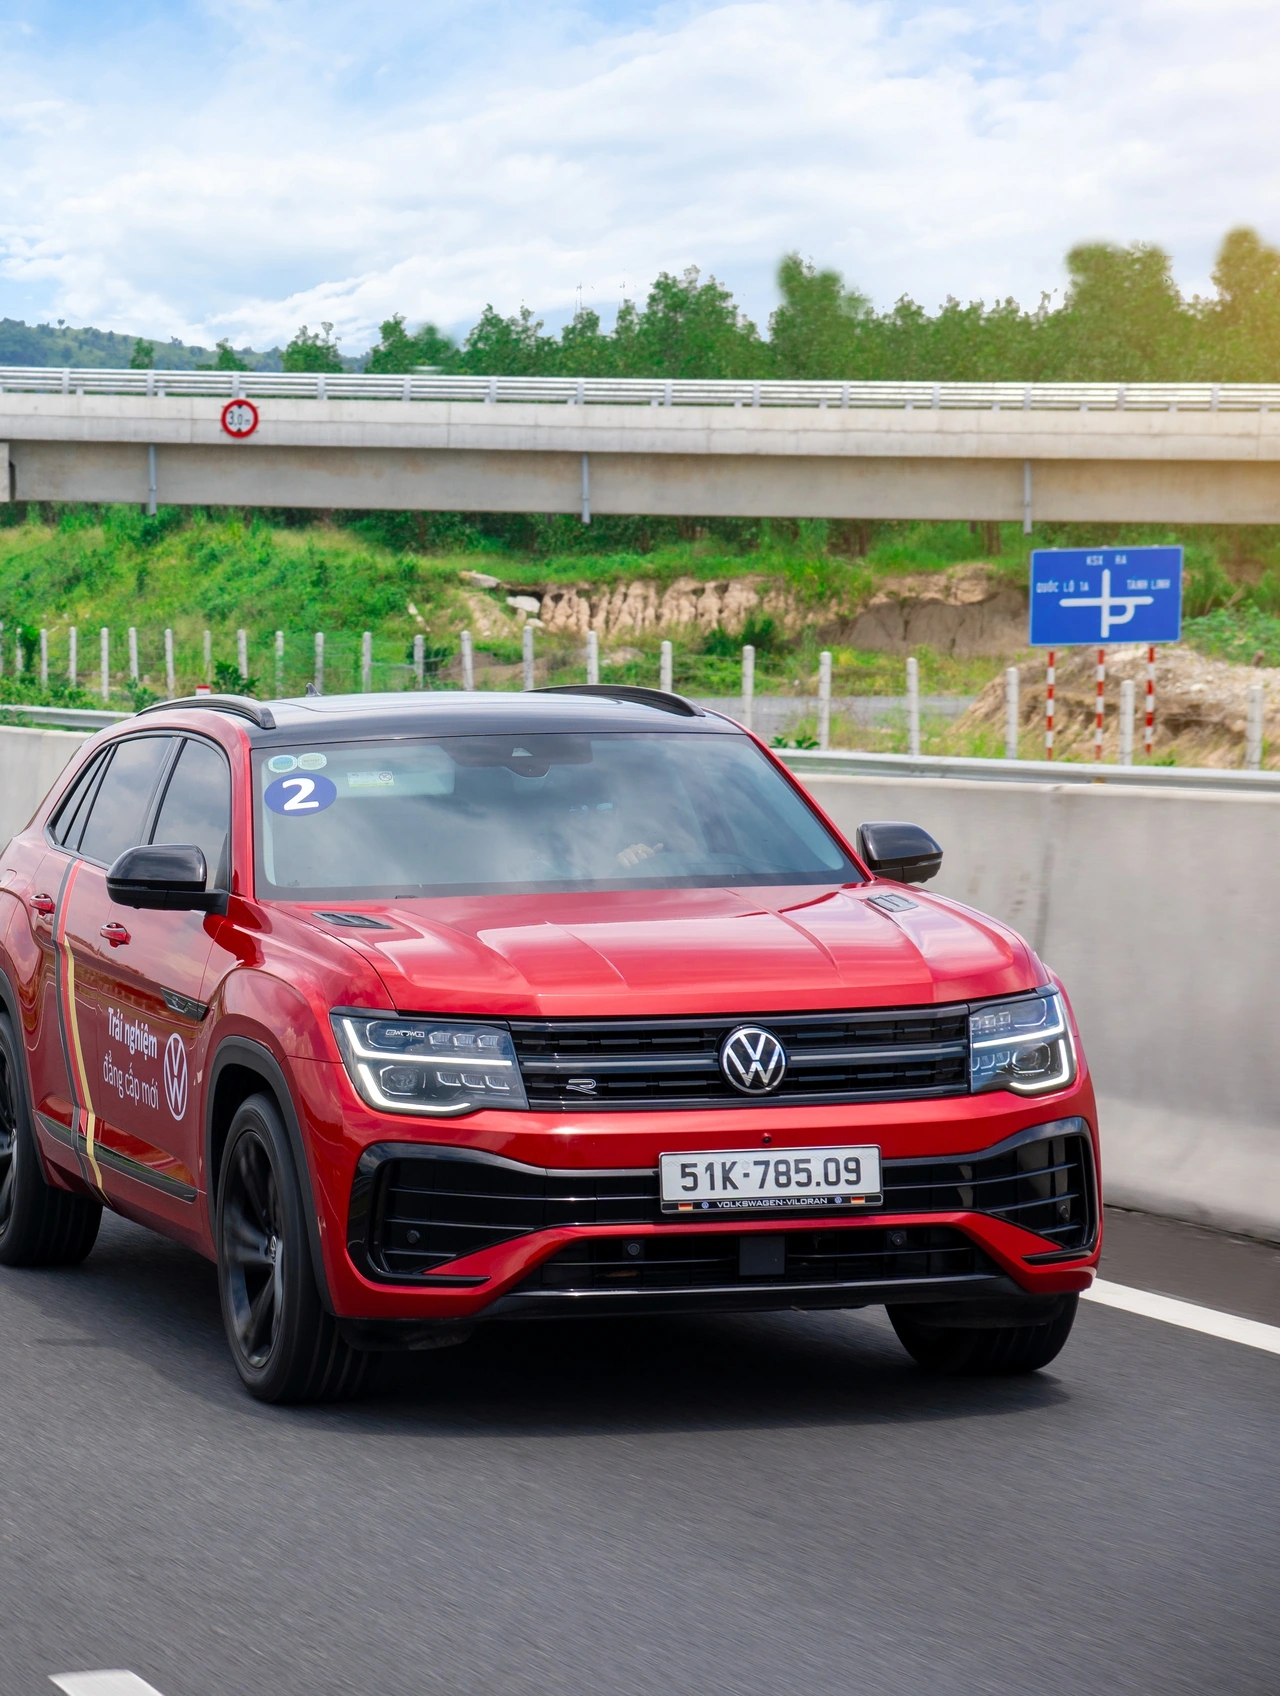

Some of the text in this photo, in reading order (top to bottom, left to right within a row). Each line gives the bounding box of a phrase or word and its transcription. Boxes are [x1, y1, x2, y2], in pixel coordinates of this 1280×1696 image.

[282, 777, 319, 811] 2
[107, 1006, 158, 1061] Trải nghiệm
[722, 1027, 787, 1094] VW
[124, 1062, 140, 1106] cấp
[141, 1078, 159, 1111] mới
[680, 1156, 862, 1192] 51K-785.09
